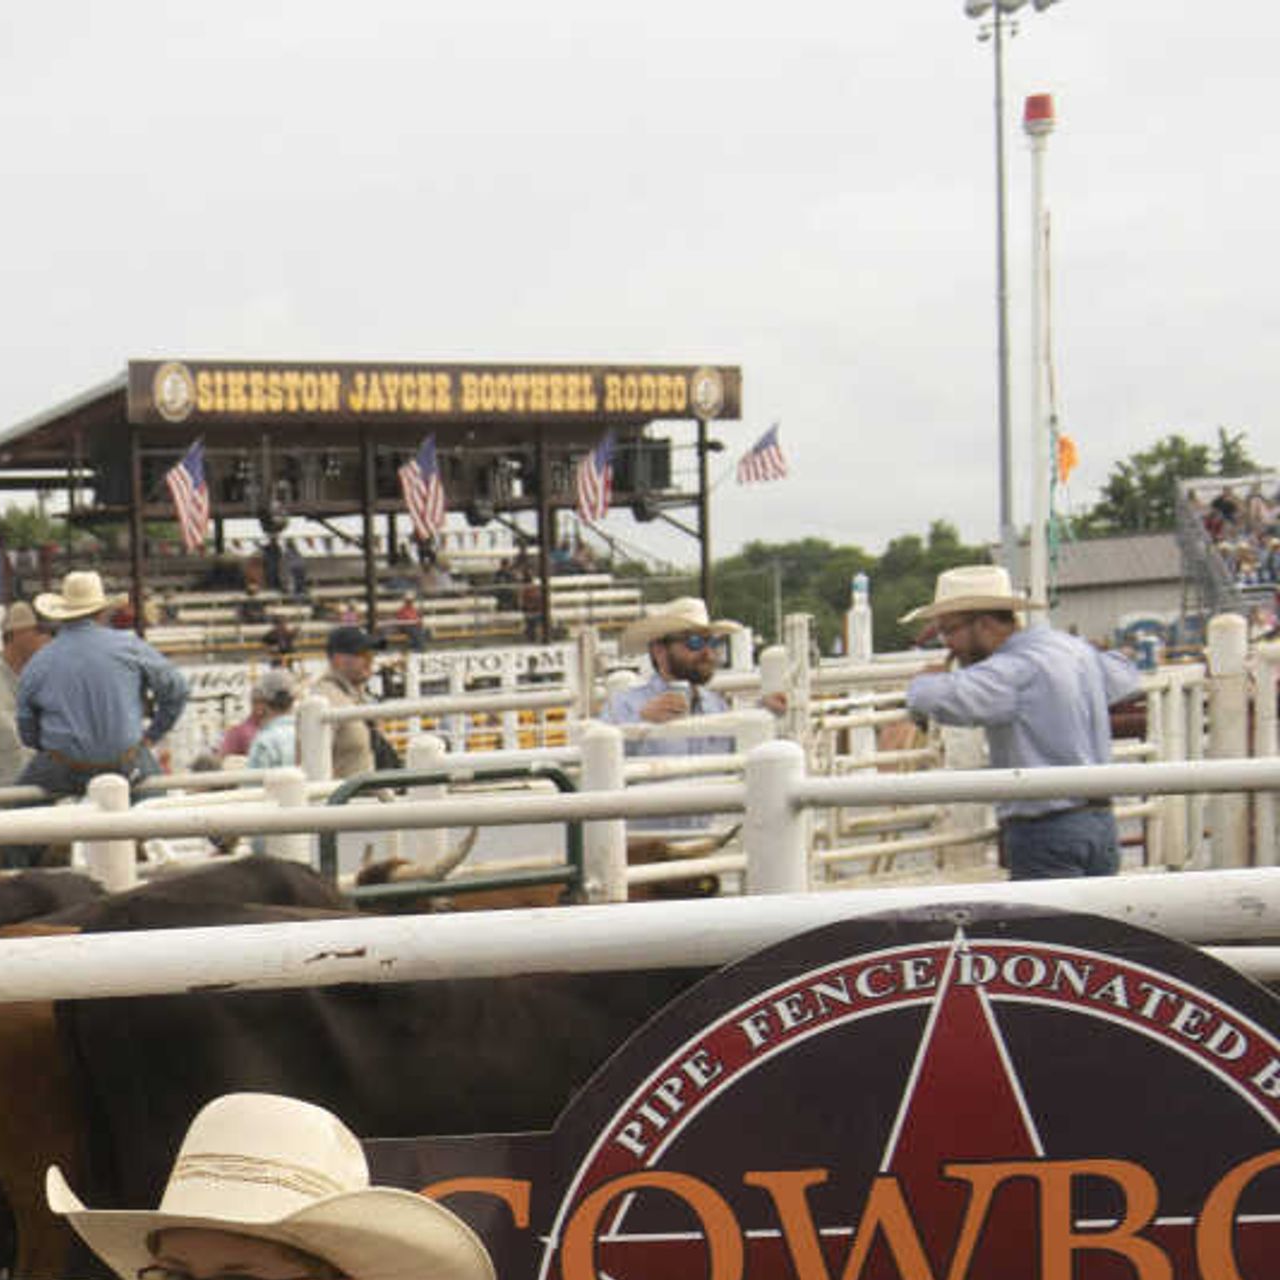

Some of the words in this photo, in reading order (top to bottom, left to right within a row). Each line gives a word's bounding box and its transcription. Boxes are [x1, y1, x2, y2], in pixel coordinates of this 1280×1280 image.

[197, 371, 339, 413] SIKESTON
[348, 371, 452, 413] JAYCEE
[460, 372, 598, 413] BOOTHEEL
[604, 373, 687, 413] RODEO
[614, 1048, 724, 1157] PIPE
[738, 956, 937, 1051] FENCE
[954, 953, 1249, 1061] DONATED
